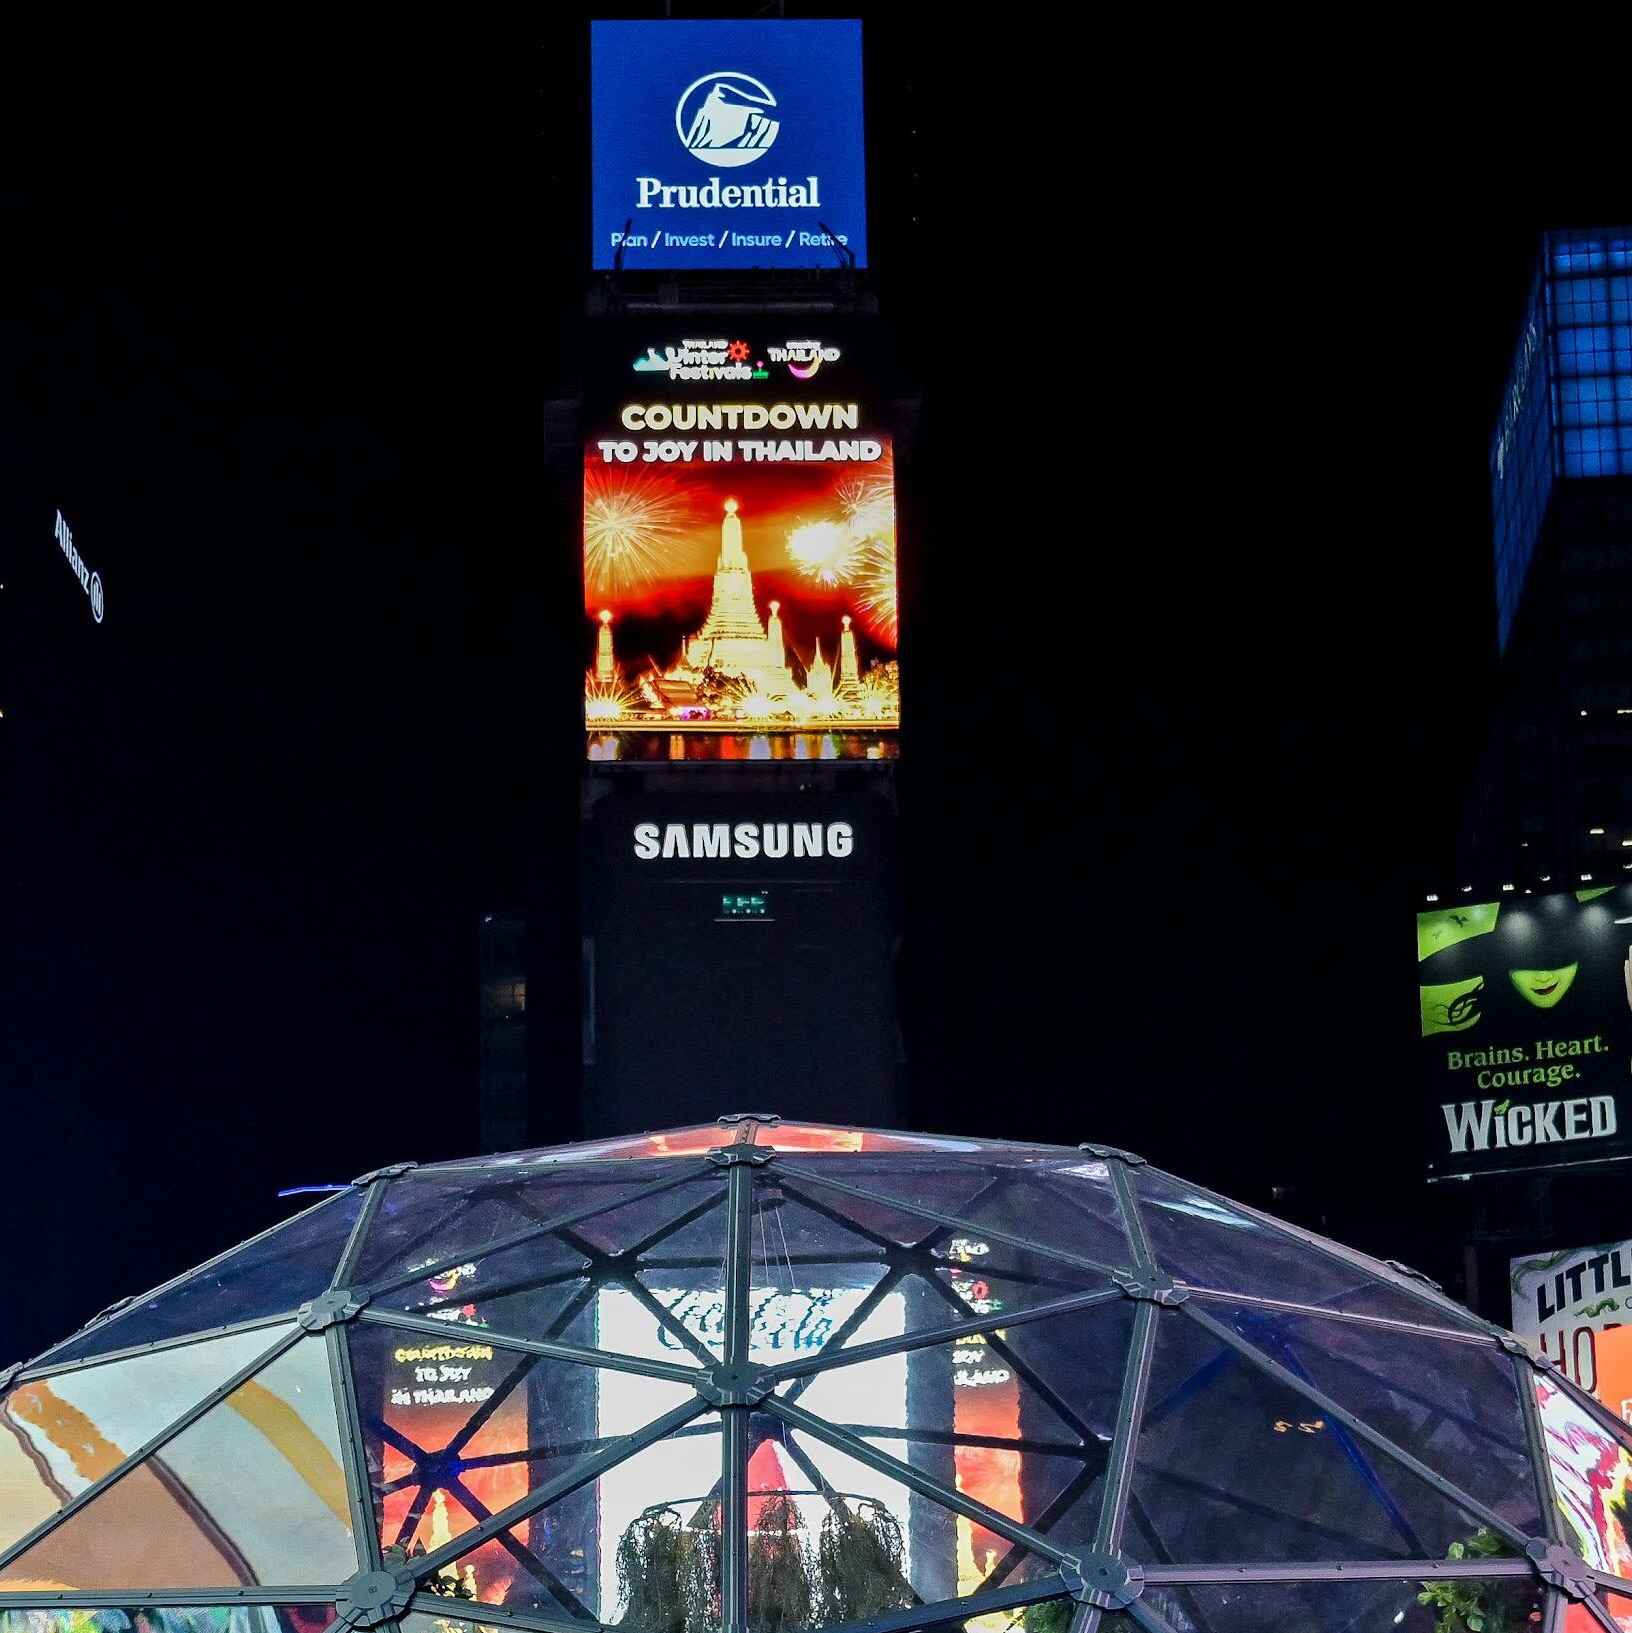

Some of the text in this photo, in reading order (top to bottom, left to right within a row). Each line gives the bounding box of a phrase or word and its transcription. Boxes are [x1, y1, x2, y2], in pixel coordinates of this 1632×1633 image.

[636, 175, 821, 208] Prudential
[664, 231, 716, 247] Invest
[732, 231, 783, 247] Insure
[666, 347, 729, 365] Winter
[768, 347, 841, 362] THAILAND
[669, 362, 753, 380] Festivals
[621, 404, 859, 431] COUNTDOWN
[598, 440, 882, 464] TO JOY IN THAILAND
[54, 509, 91, 595] Allianz
[633, 822, 855, 860] SAMSUNG
[1447, 1034, 1610, 1070] Brains. Heart.
[1477, 1063, 1581, 1089] Courage.
